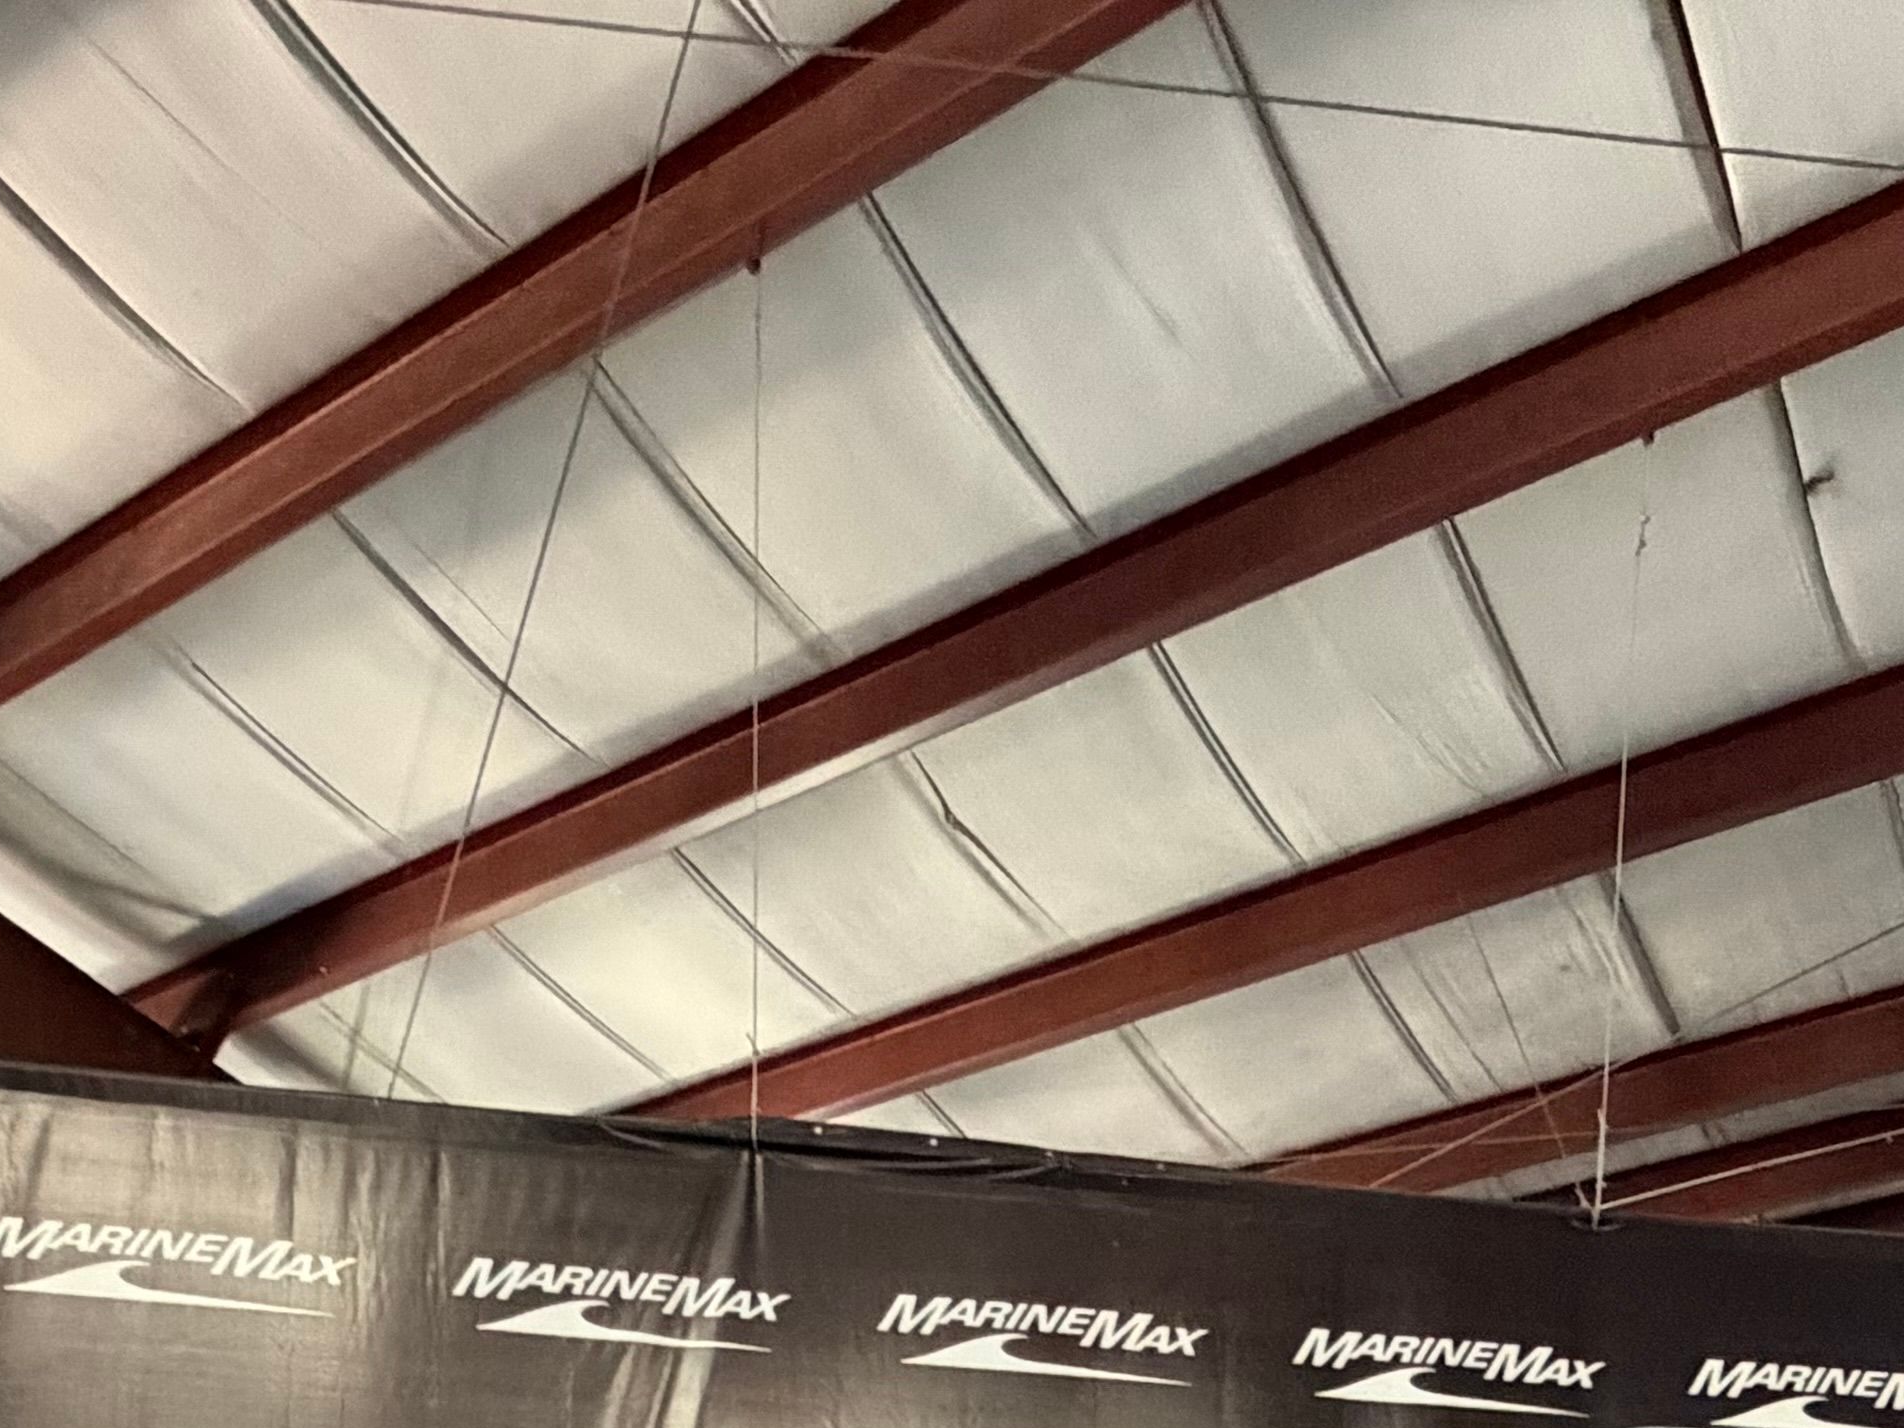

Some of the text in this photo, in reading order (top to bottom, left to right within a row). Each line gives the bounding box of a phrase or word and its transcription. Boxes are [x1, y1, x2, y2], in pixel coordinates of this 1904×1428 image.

[452, 1257, 790, 1321] MARINEMAX
[877, 1294, 1207, 1355] MARINEMAX
[1293, 1328, 1605, 1388] MARINEMAX
